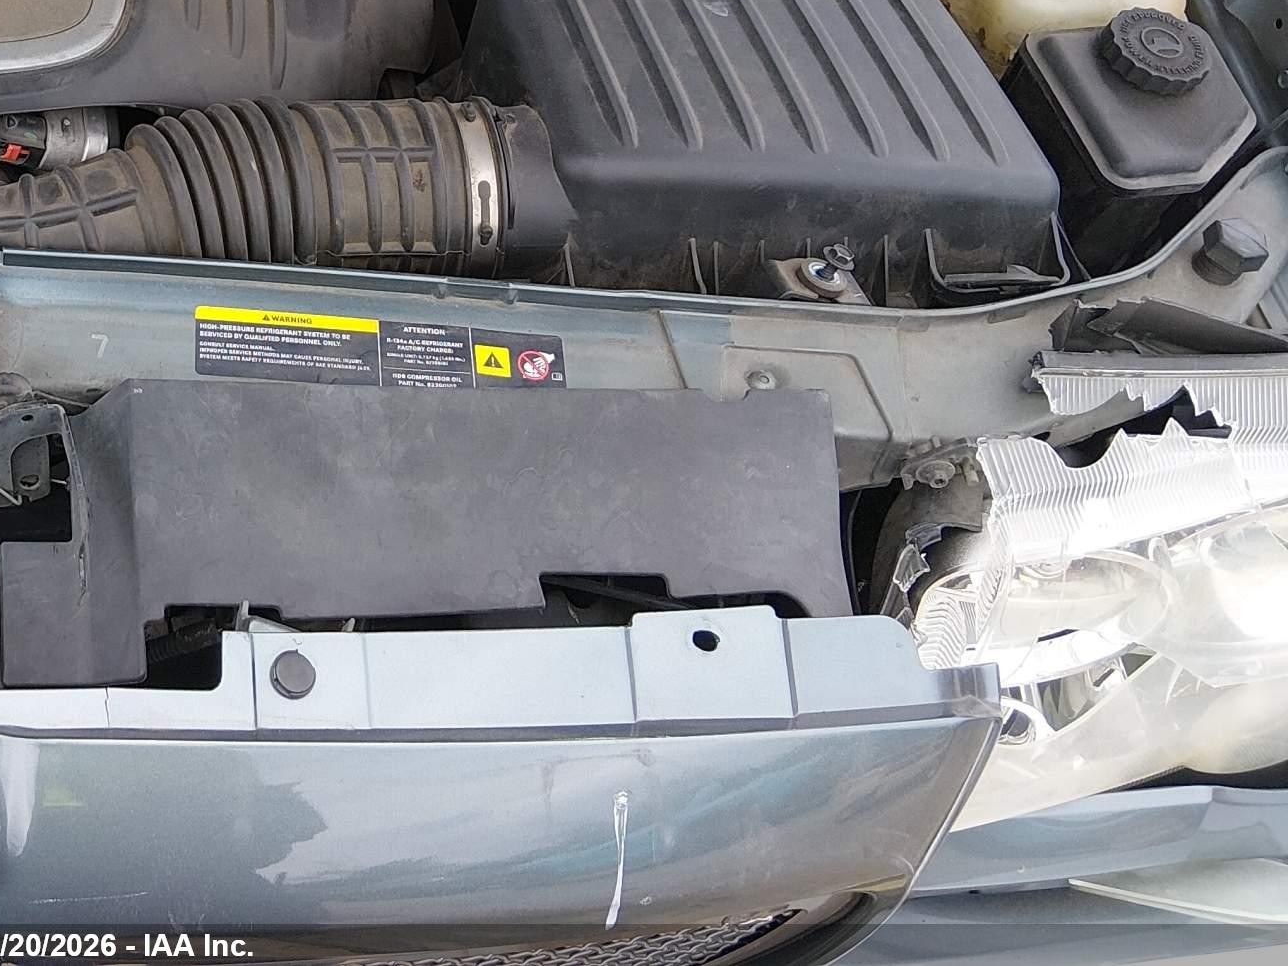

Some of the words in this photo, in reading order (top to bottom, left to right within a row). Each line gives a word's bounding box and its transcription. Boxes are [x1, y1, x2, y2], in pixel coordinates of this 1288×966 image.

[272, 315, 312, 325] WARNING
[199, 322, 255, 333] HIGH-PRESSURE
[256, 327, 302, 337] REFRIGERANT
[303, 330, 330, 339] SYSTEM
[331, 332, 341, 340] TO
[342, 333, 352, 341] BE
[403, 326, 446, 336] ATTENTION
[199, 330, 232, 339] SERVICED
[244, 333, 280, 342] QUALIFIED
[281, 336, 322, 345] PERSONNEL
